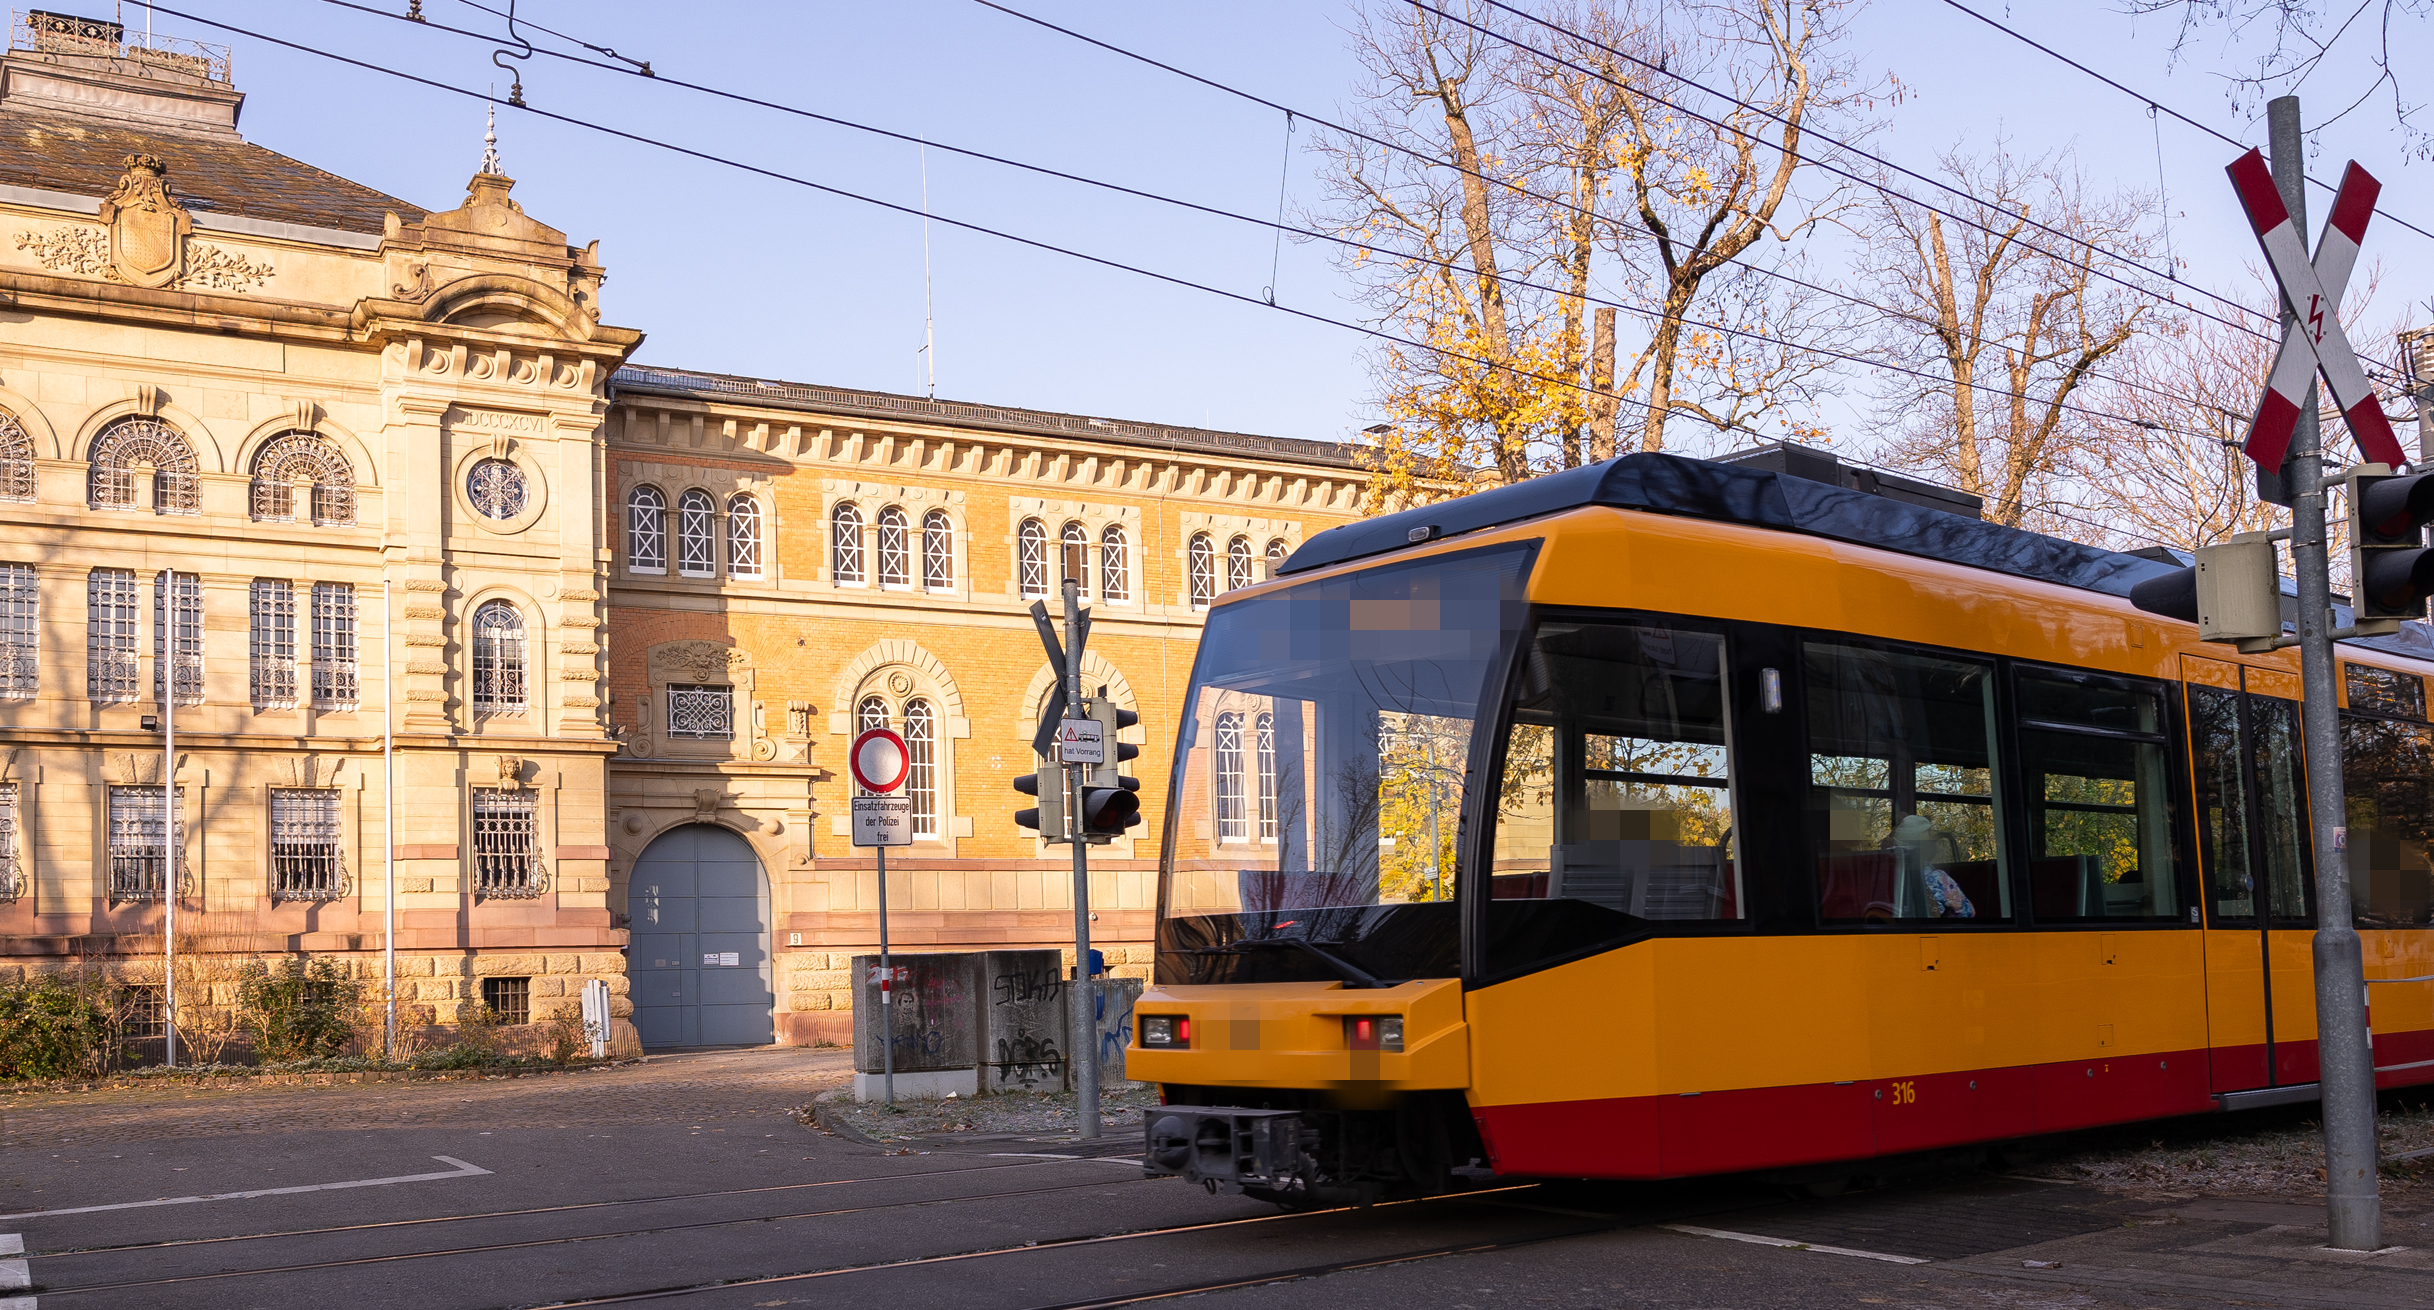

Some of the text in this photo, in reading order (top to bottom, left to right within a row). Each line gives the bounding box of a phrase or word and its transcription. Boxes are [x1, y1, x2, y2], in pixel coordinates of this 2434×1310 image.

[1064, 746, 1101, 757] hat Vorrang
[854, 800, 910, 813] Einsatzfahrzeuge
[865, 815, 899, 827] der Polizei
[877, 831, 889, 842] frei
[792, 933, 799, 944] 9
[1892, 1081, 1916, 1105] 316
